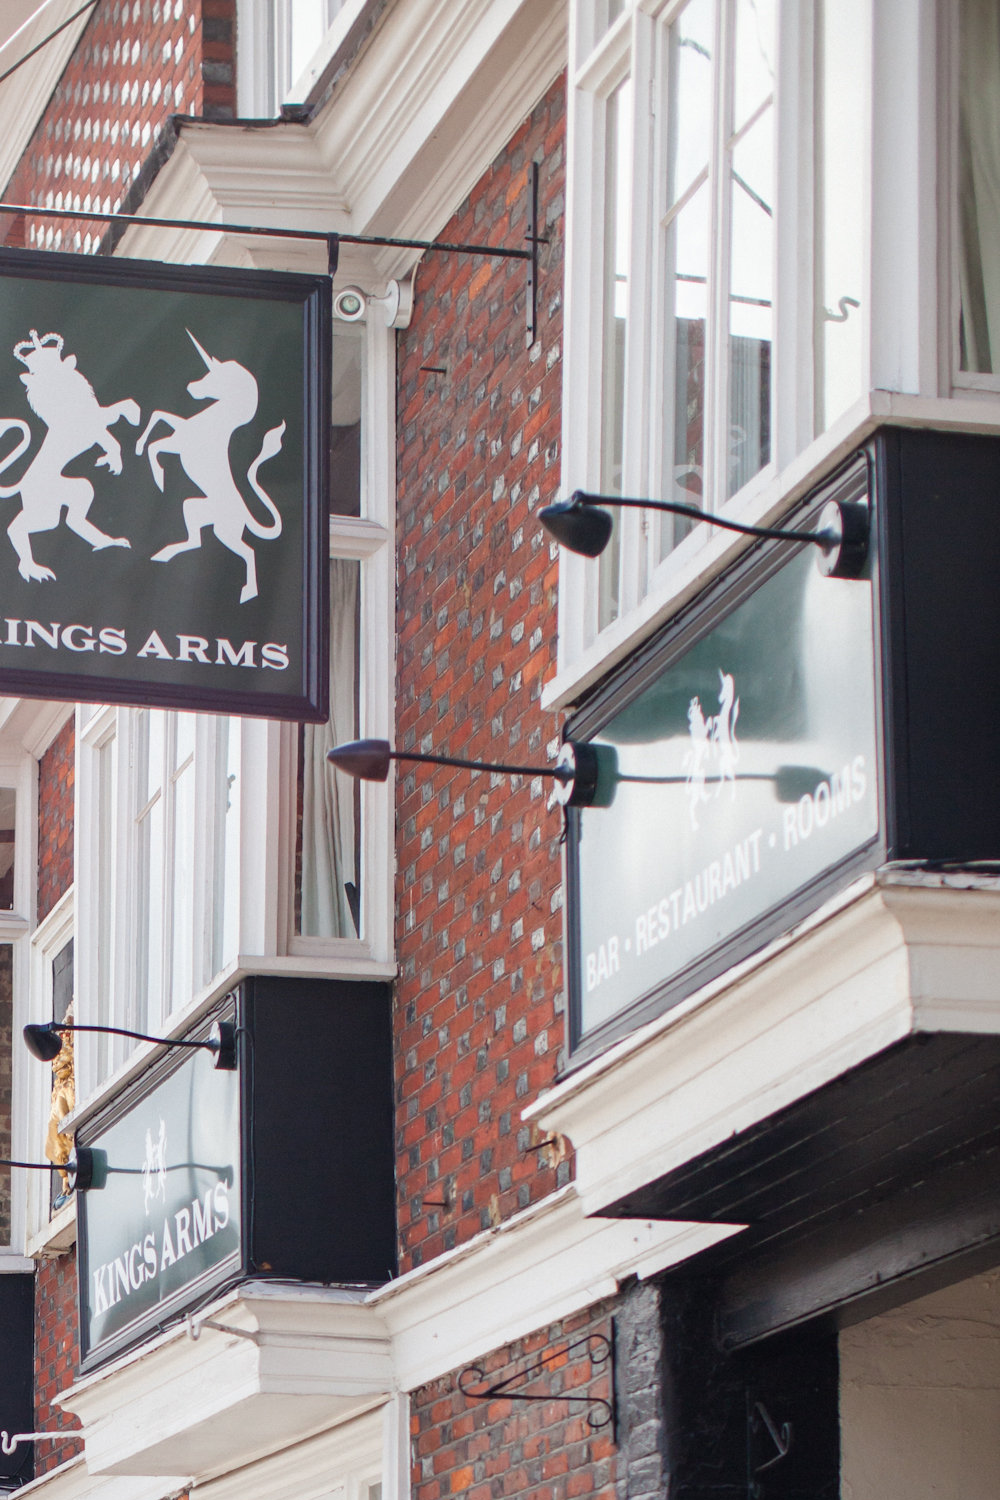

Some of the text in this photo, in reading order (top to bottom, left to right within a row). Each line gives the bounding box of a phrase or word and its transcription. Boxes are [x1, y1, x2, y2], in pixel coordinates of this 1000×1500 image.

[137, 630, 290, 670] ARMS
[586, 755, 867, 992] BAR RESTAURANT ROOMS
[92, 1179, 230, 1318] KINGS ARMS
